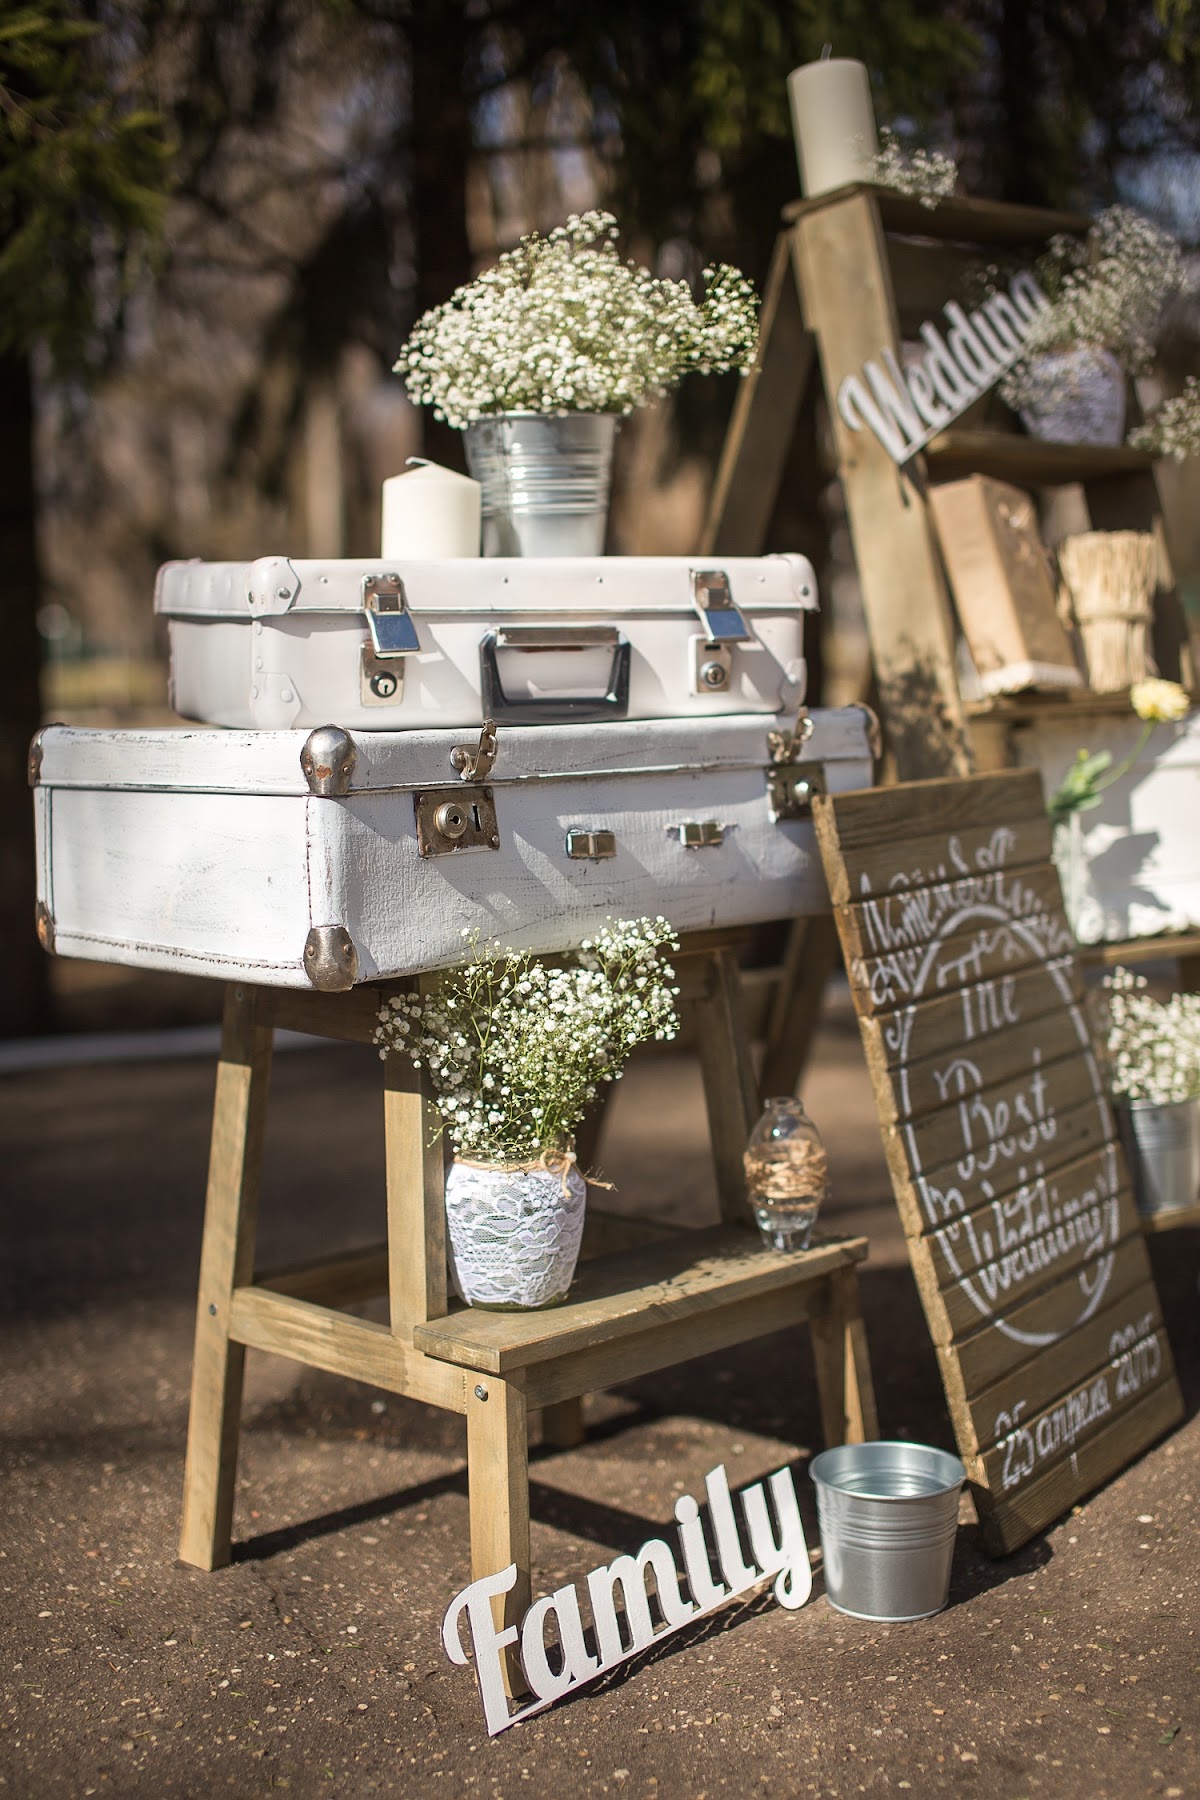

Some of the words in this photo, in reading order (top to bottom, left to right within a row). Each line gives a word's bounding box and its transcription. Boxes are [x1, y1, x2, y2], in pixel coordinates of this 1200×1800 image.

[936, 927, 1027, 1038] The
[932, 1047, 1057, 1181] Best
[928, 1160, 1110, 1297] Wedding
[441, 1464, 813, 1737] Family
